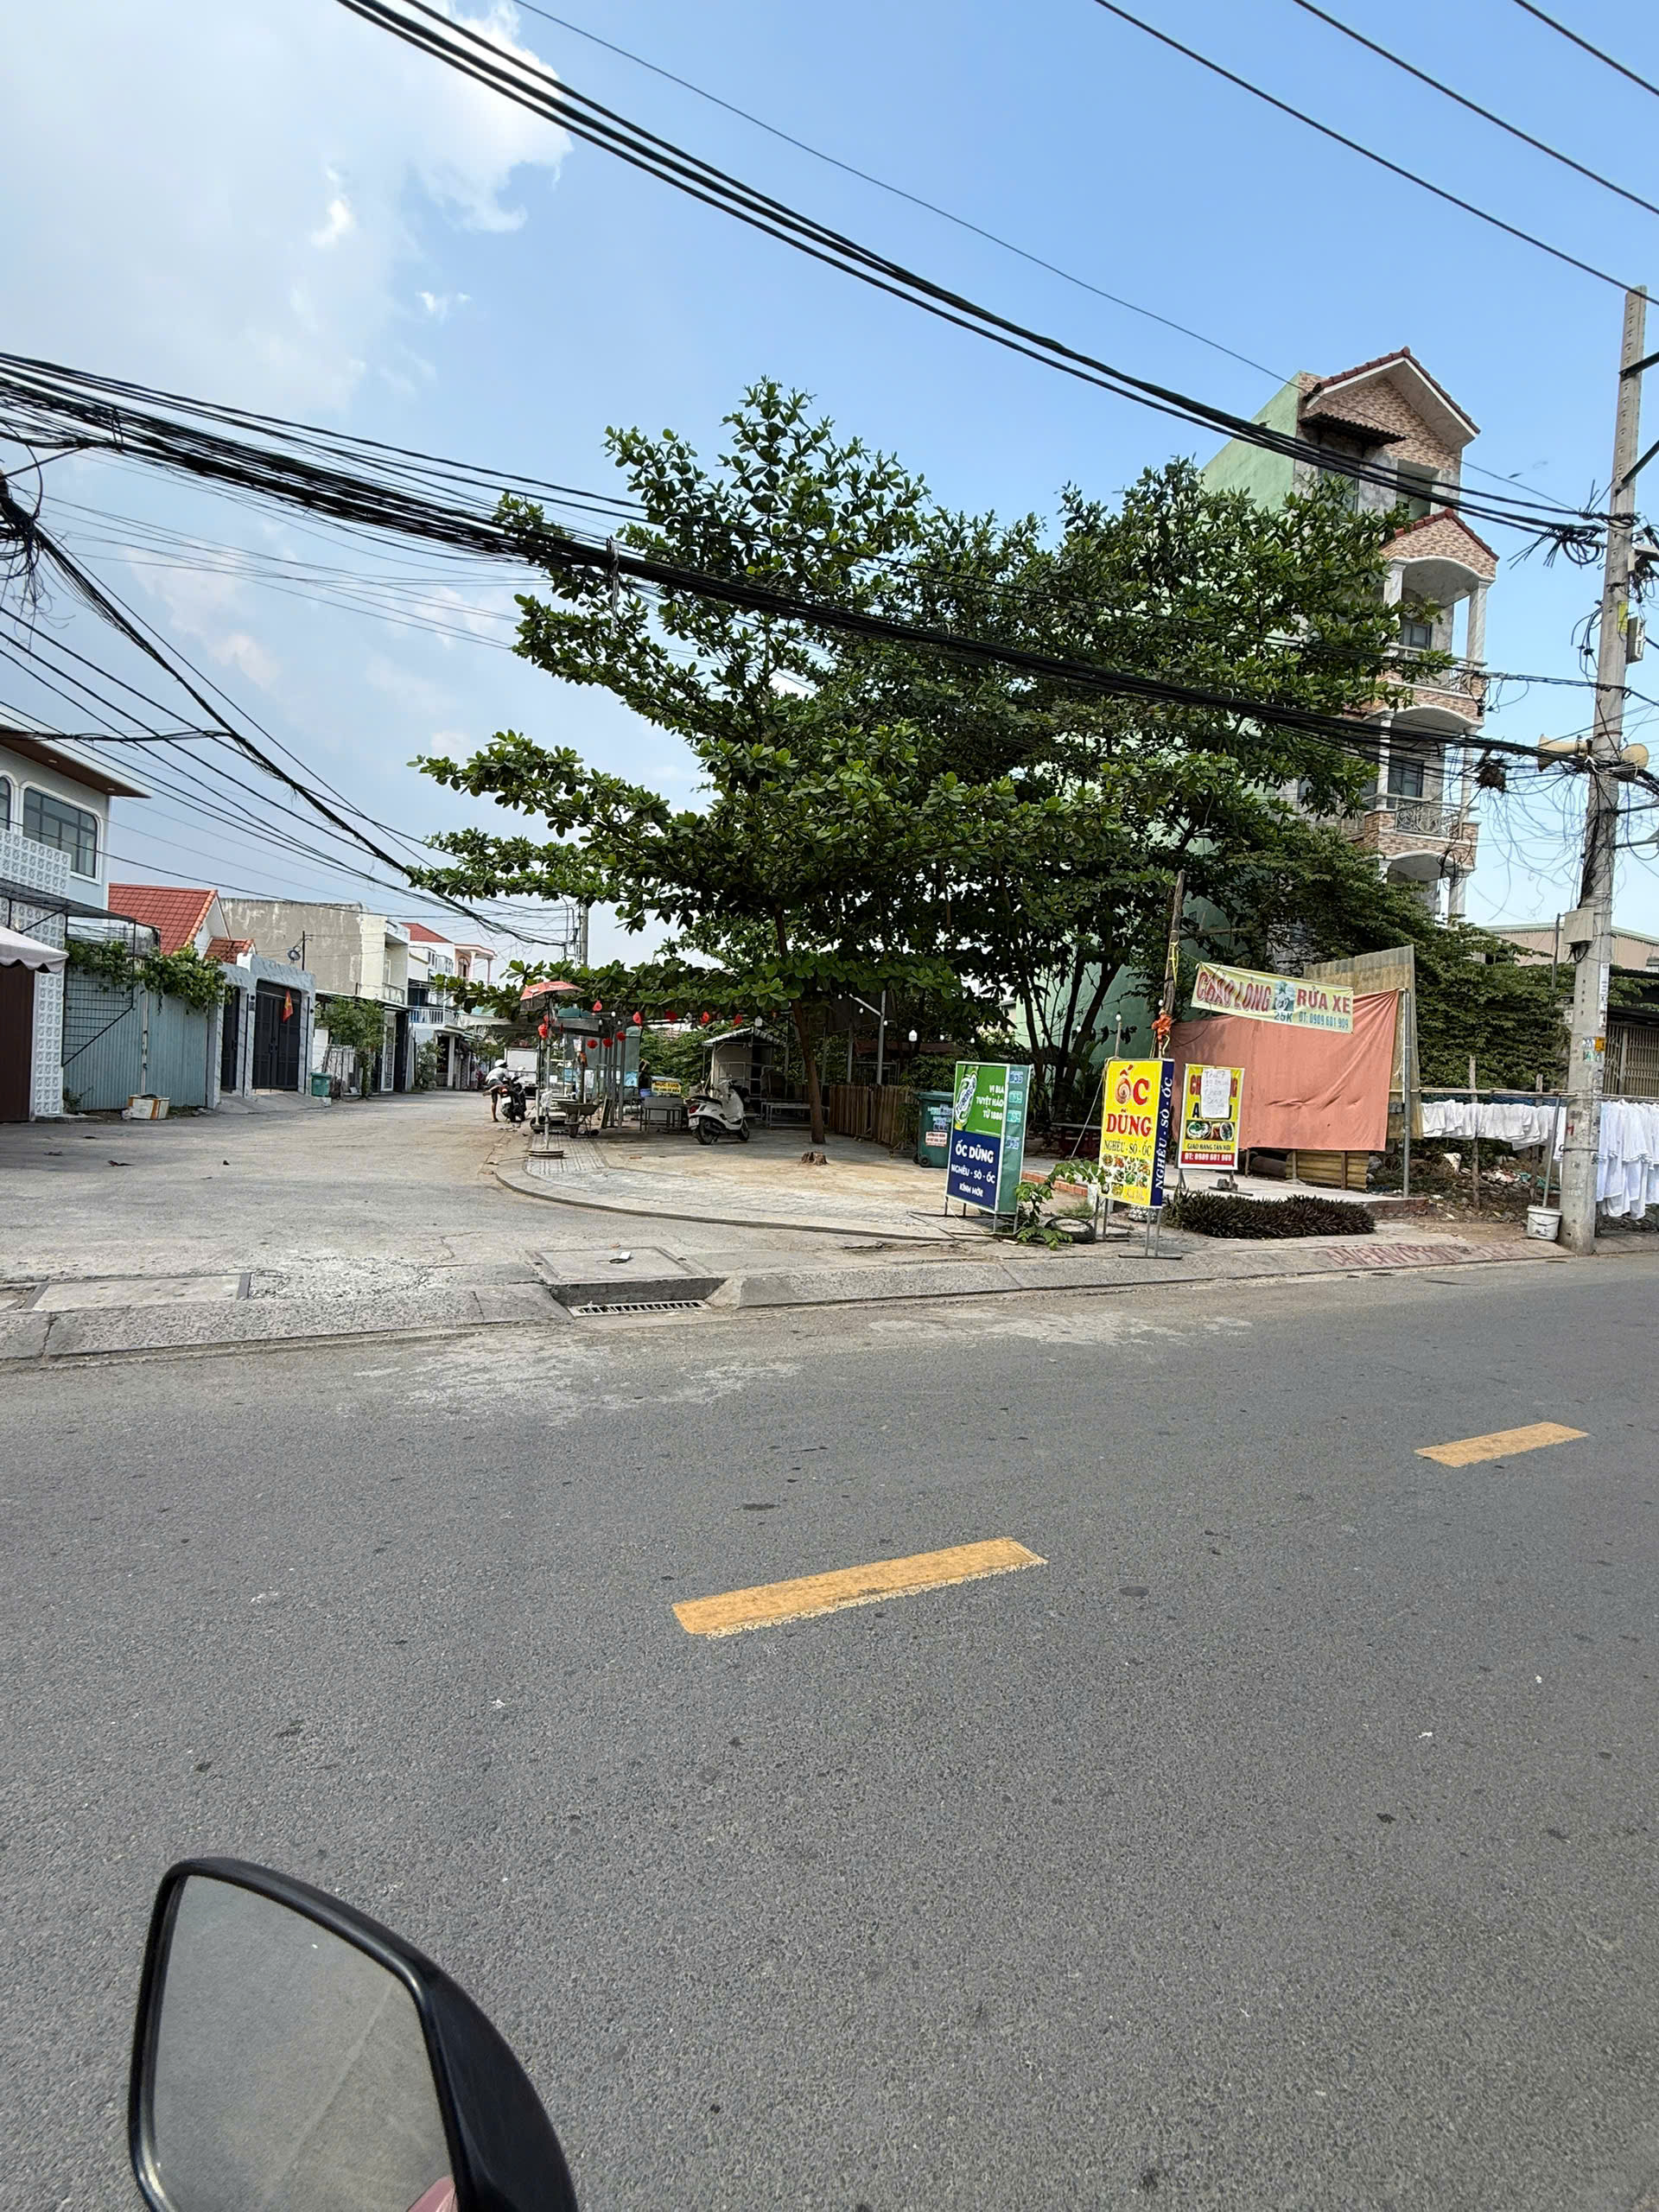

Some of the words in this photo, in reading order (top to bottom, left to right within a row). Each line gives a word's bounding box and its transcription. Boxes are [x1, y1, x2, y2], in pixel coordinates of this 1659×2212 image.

[1296, 984, 1327, 1009] RỬA
[1332, 995, 1351, 1014] XE
[1274, 1011, 1294, 1023] 25K
[1309, 1013, 1325, 1025] 0909
[995, 1085, 1004, 1094] BIA
[1115, 1064, 1150, 1105] ỐC
[1161, 1077, 1173, 1098] ỐC
[1106, 1109, 1152, 1137] DŨNG
[1160, 1109, 1170, 1128] SÒ
[955, 1139, 968, 1157] ỐC
[969, 1143, 995, 1164] DŨNG
[1128, 1141, 1138, 1154] SÒ
[1141, 1140, 1152, 1156] ỐC
[951, 1164, 969, 1176] NGHÊU
[973, 1168, 982, 1180] SÒ
[986, 1171, 996, 1184] ỐC
[1155, 1138, 1167, 1190] NGHÊU
